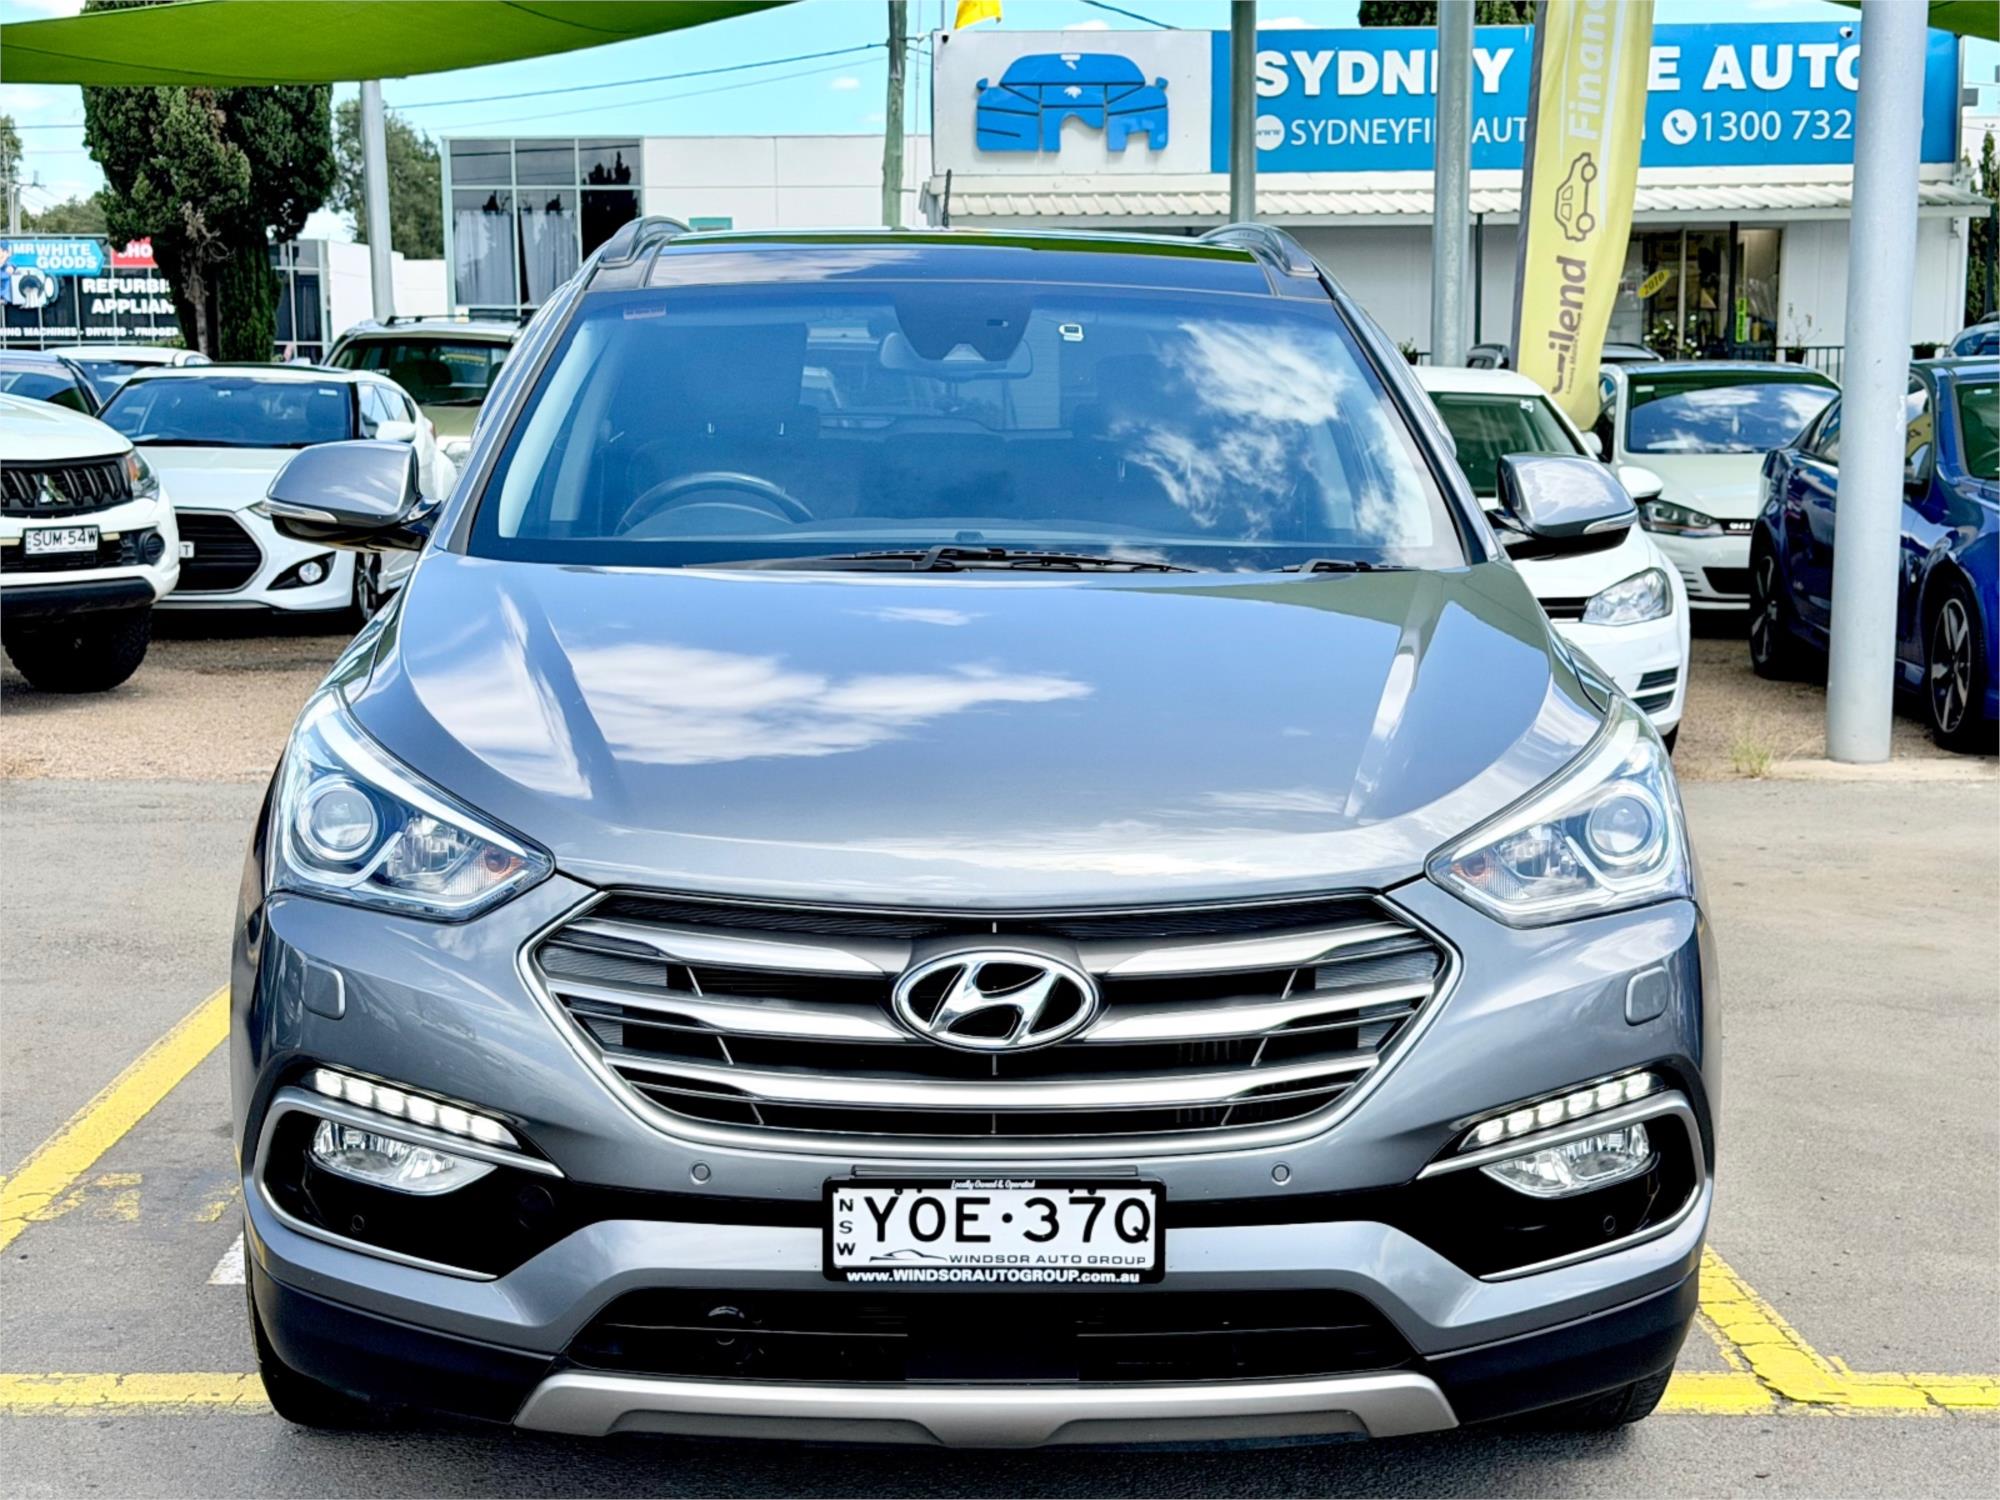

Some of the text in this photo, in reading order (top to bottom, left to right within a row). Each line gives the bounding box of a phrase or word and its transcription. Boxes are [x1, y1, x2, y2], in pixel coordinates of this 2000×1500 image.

[1256, 48, 1514, 97] SYDNY
[1700, 109, 1852, 142] 1300 732
[36, 256, 97, 270] GOODS
[23, 327, 78, 337] MACHINES
[85, 327, 127, 337] DRYERS
[950, 1254, 1146, 1265] WINDSOR AUTO GROUP
[847, 1269, 1140, 1283] www.WINDSORAUTOGROUP.com.au
